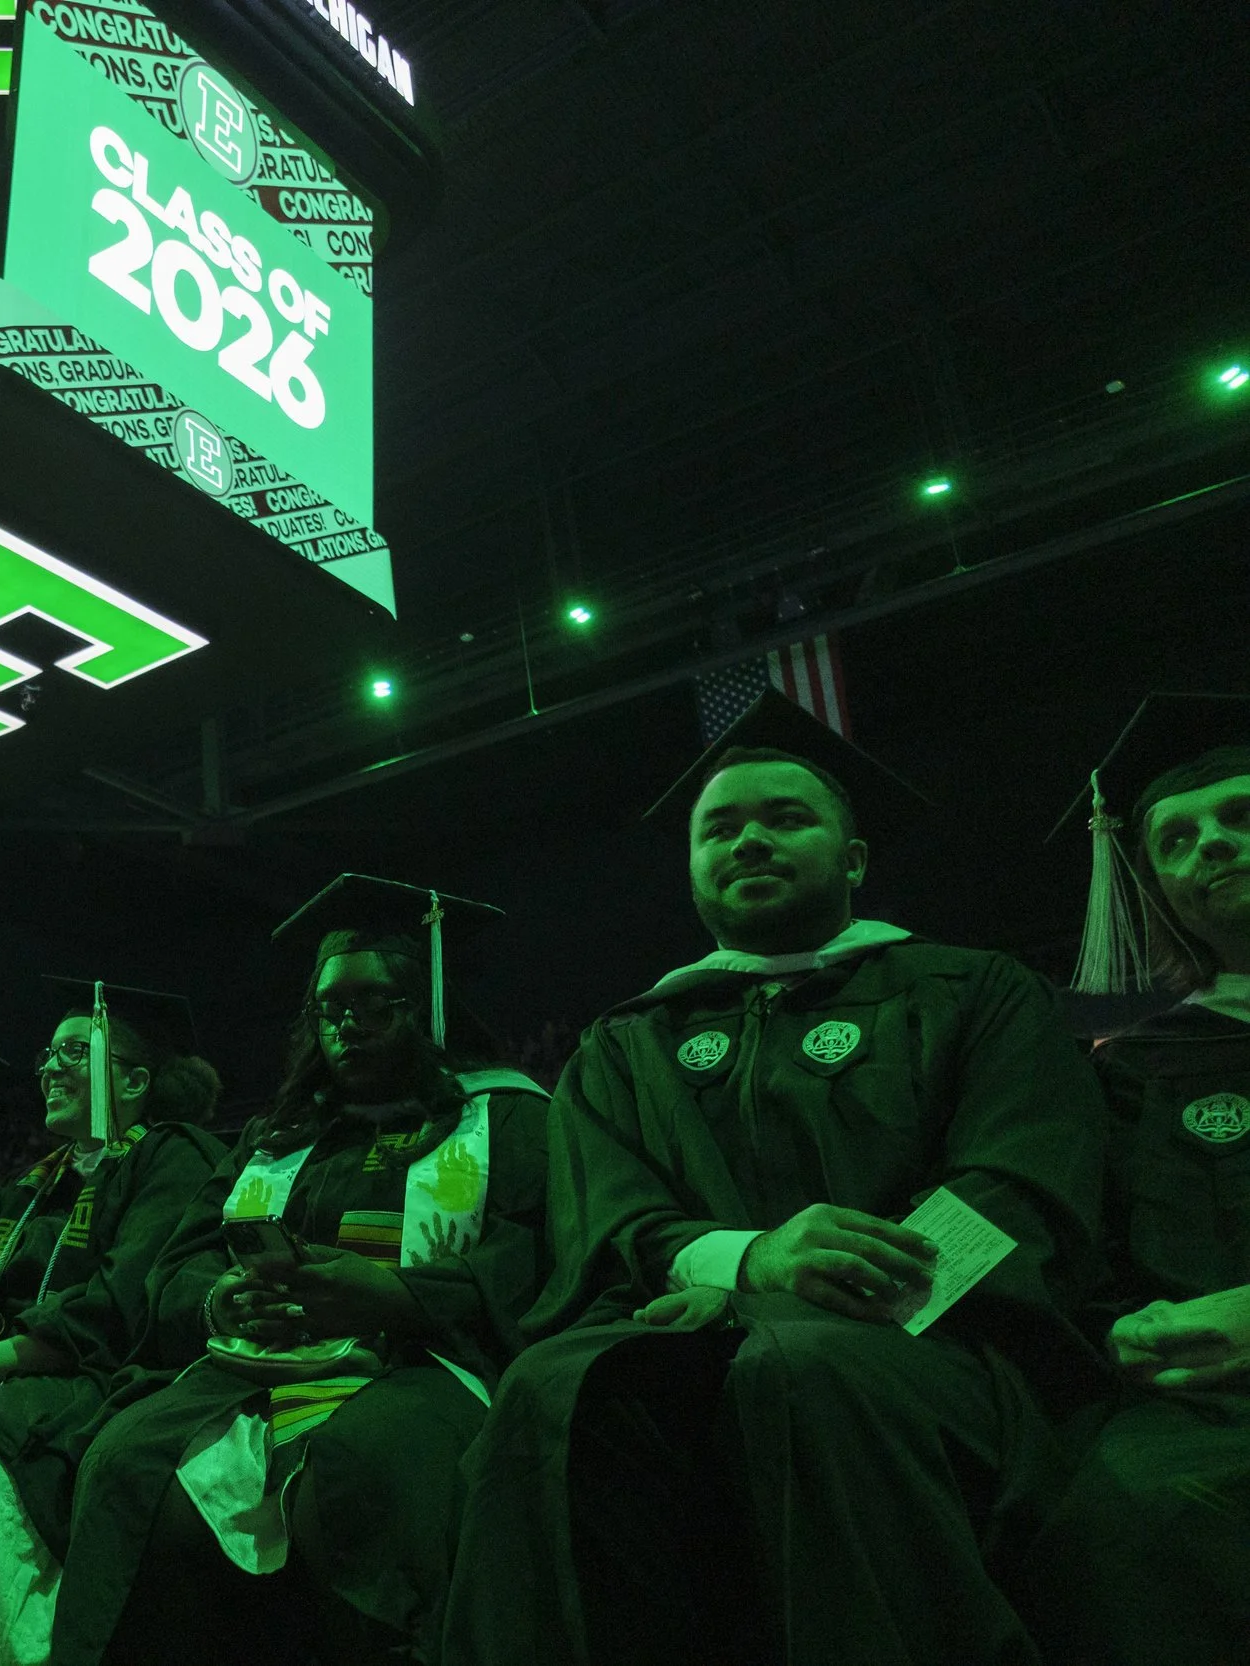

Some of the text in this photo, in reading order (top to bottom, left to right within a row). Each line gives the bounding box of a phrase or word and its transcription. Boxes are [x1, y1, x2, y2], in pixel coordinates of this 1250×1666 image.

[88, 188, 325, 429] 2026
[89, 126, 330, 340] CLASS OF
